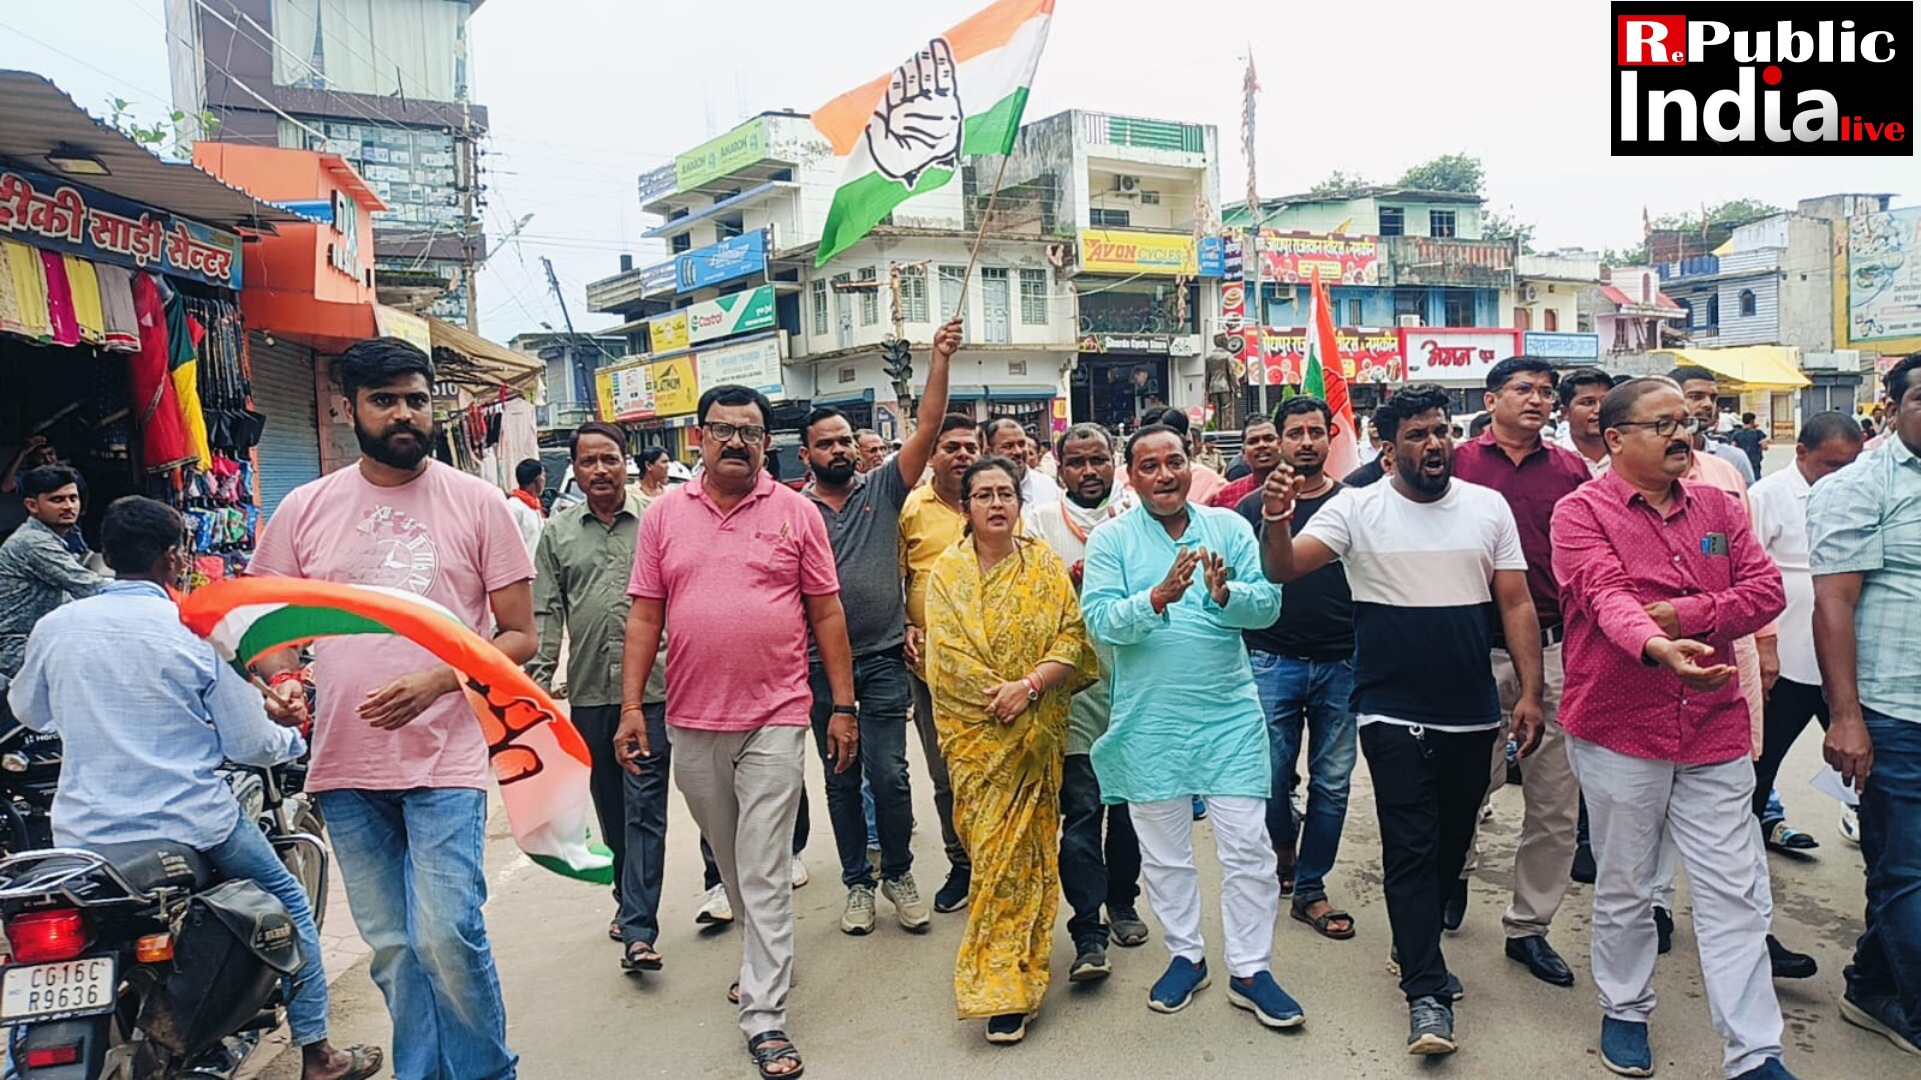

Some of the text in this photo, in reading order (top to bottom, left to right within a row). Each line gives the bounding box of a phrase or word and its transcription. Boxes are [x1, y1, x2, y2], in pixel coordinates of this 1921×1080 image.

[165, 221, 233, 280] सेन्टर
[1083, 238, 1182, 263] AVON CYCLES
[699, 312, 723, 328] Castrol
[31, 961, 99, 989] CG16C
[29, 984, 98, 1012] R9636
